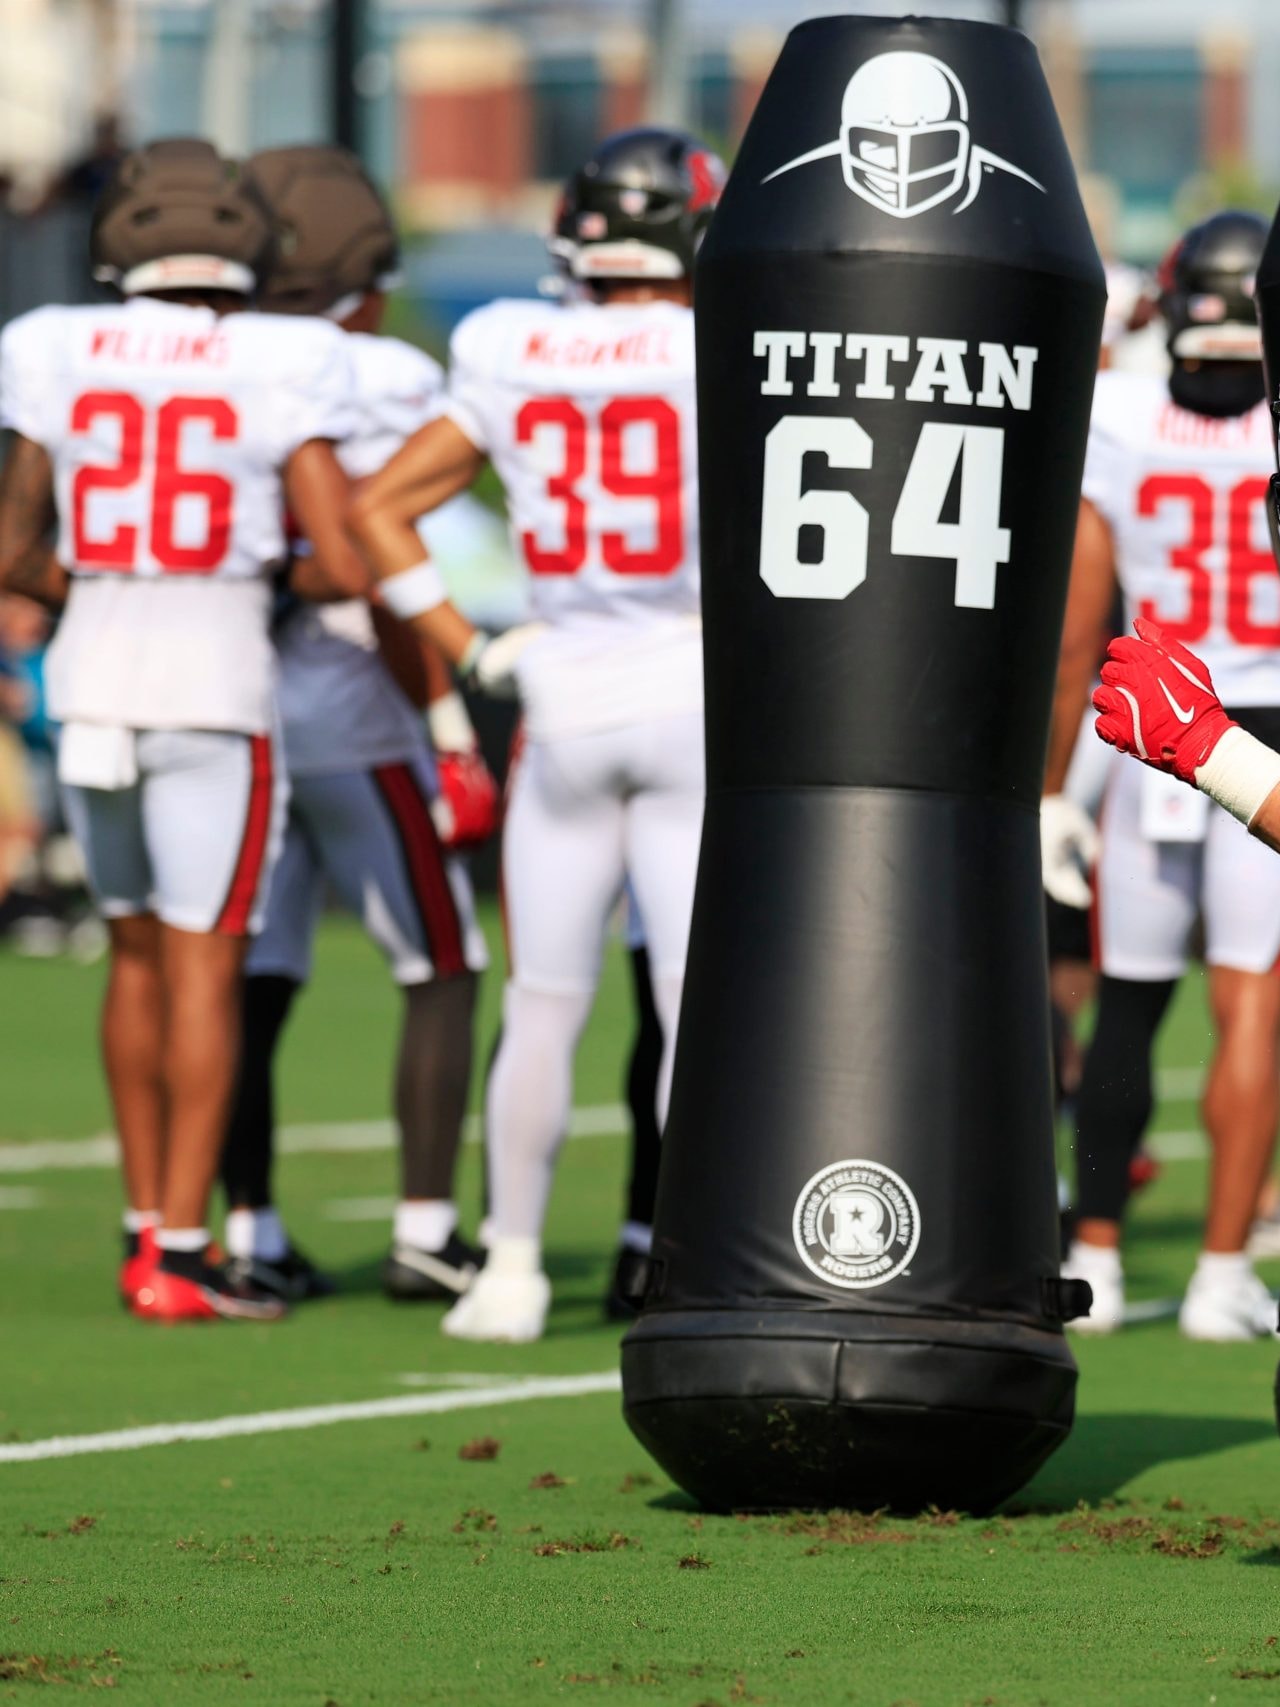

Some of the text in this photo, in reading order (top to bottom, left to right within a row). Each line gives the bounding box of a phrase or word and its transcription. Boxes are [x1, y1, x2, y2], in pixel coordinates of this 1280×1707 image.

[753, 331, 1038, 411] TITAN
[71, 389, 238, 574] 26
[515, 395, 685, 577] 39
[759, 414, 1011, 610] 64
[803, 1169, 910, 1246] ROGERS ATHLETIC COMPANY
[829, 1191, 885, 1256] R
[820, 1254, 894, 1279] ROGERS
